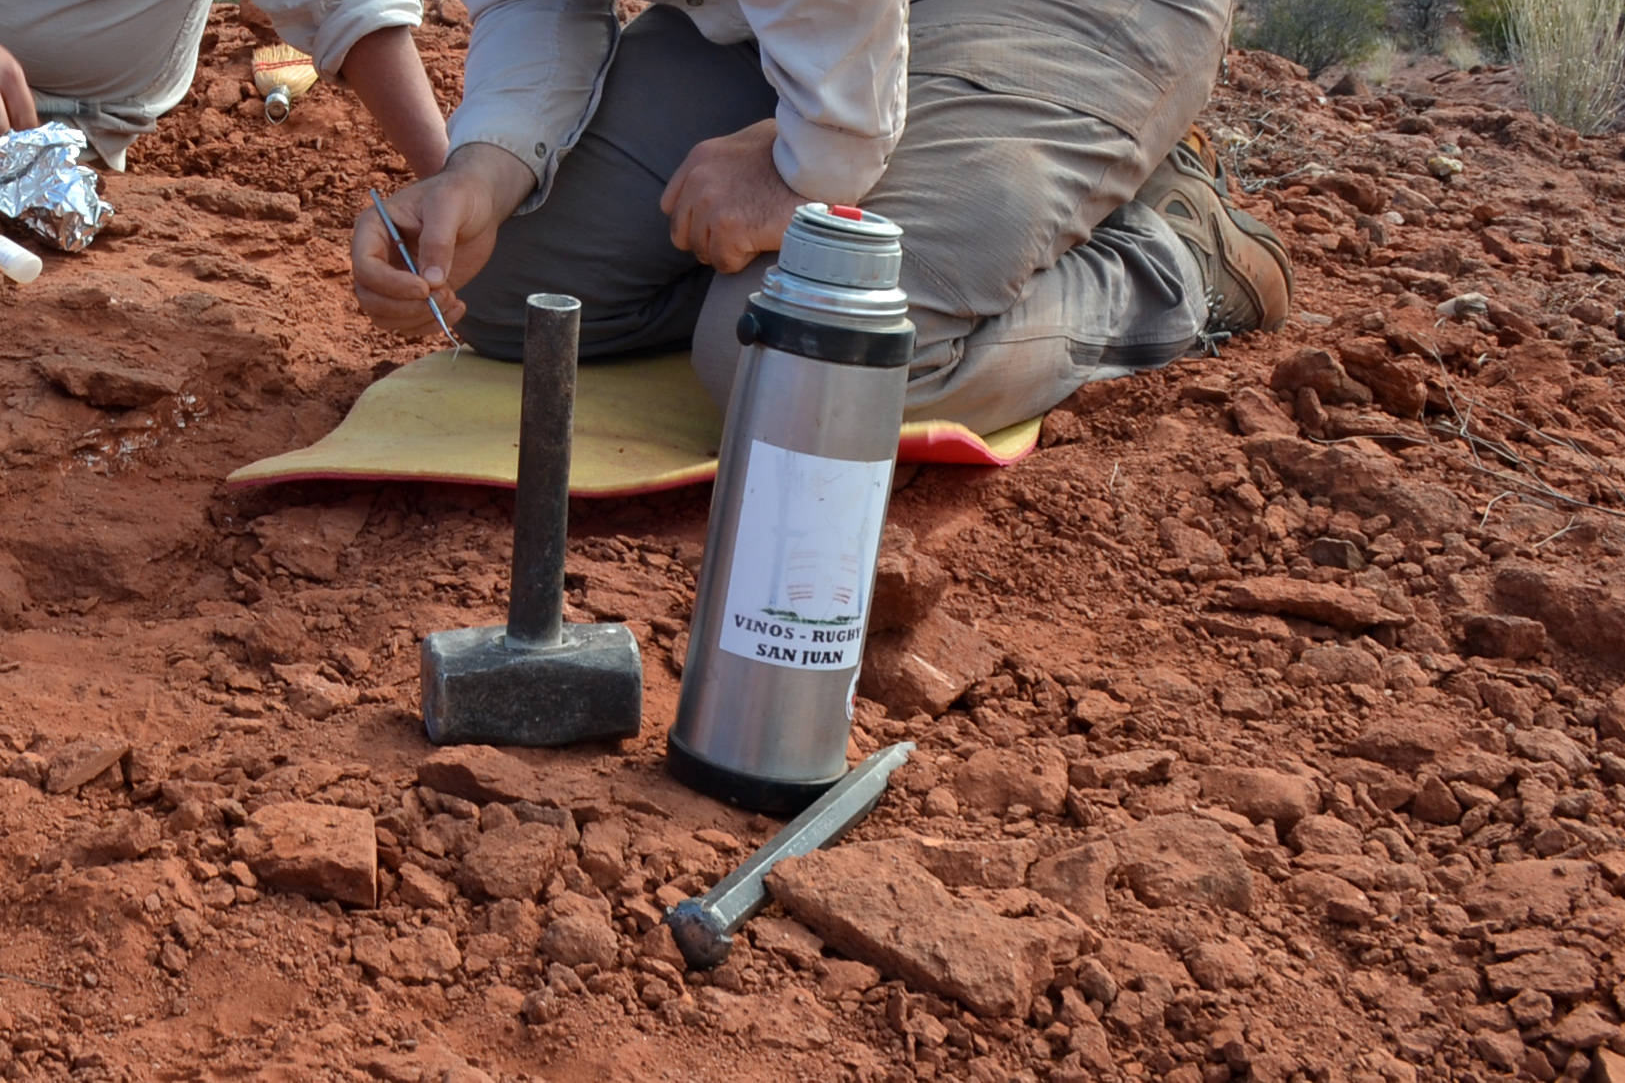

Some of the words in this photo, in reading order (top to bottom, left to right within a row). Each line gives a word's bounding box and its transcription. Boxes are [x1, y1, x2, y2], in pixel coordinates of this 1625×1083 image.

[734, 614, 795, 640] VINOS
[756, 643, 797, 662] SAN
[802, 650, 844, 665] JUAN
